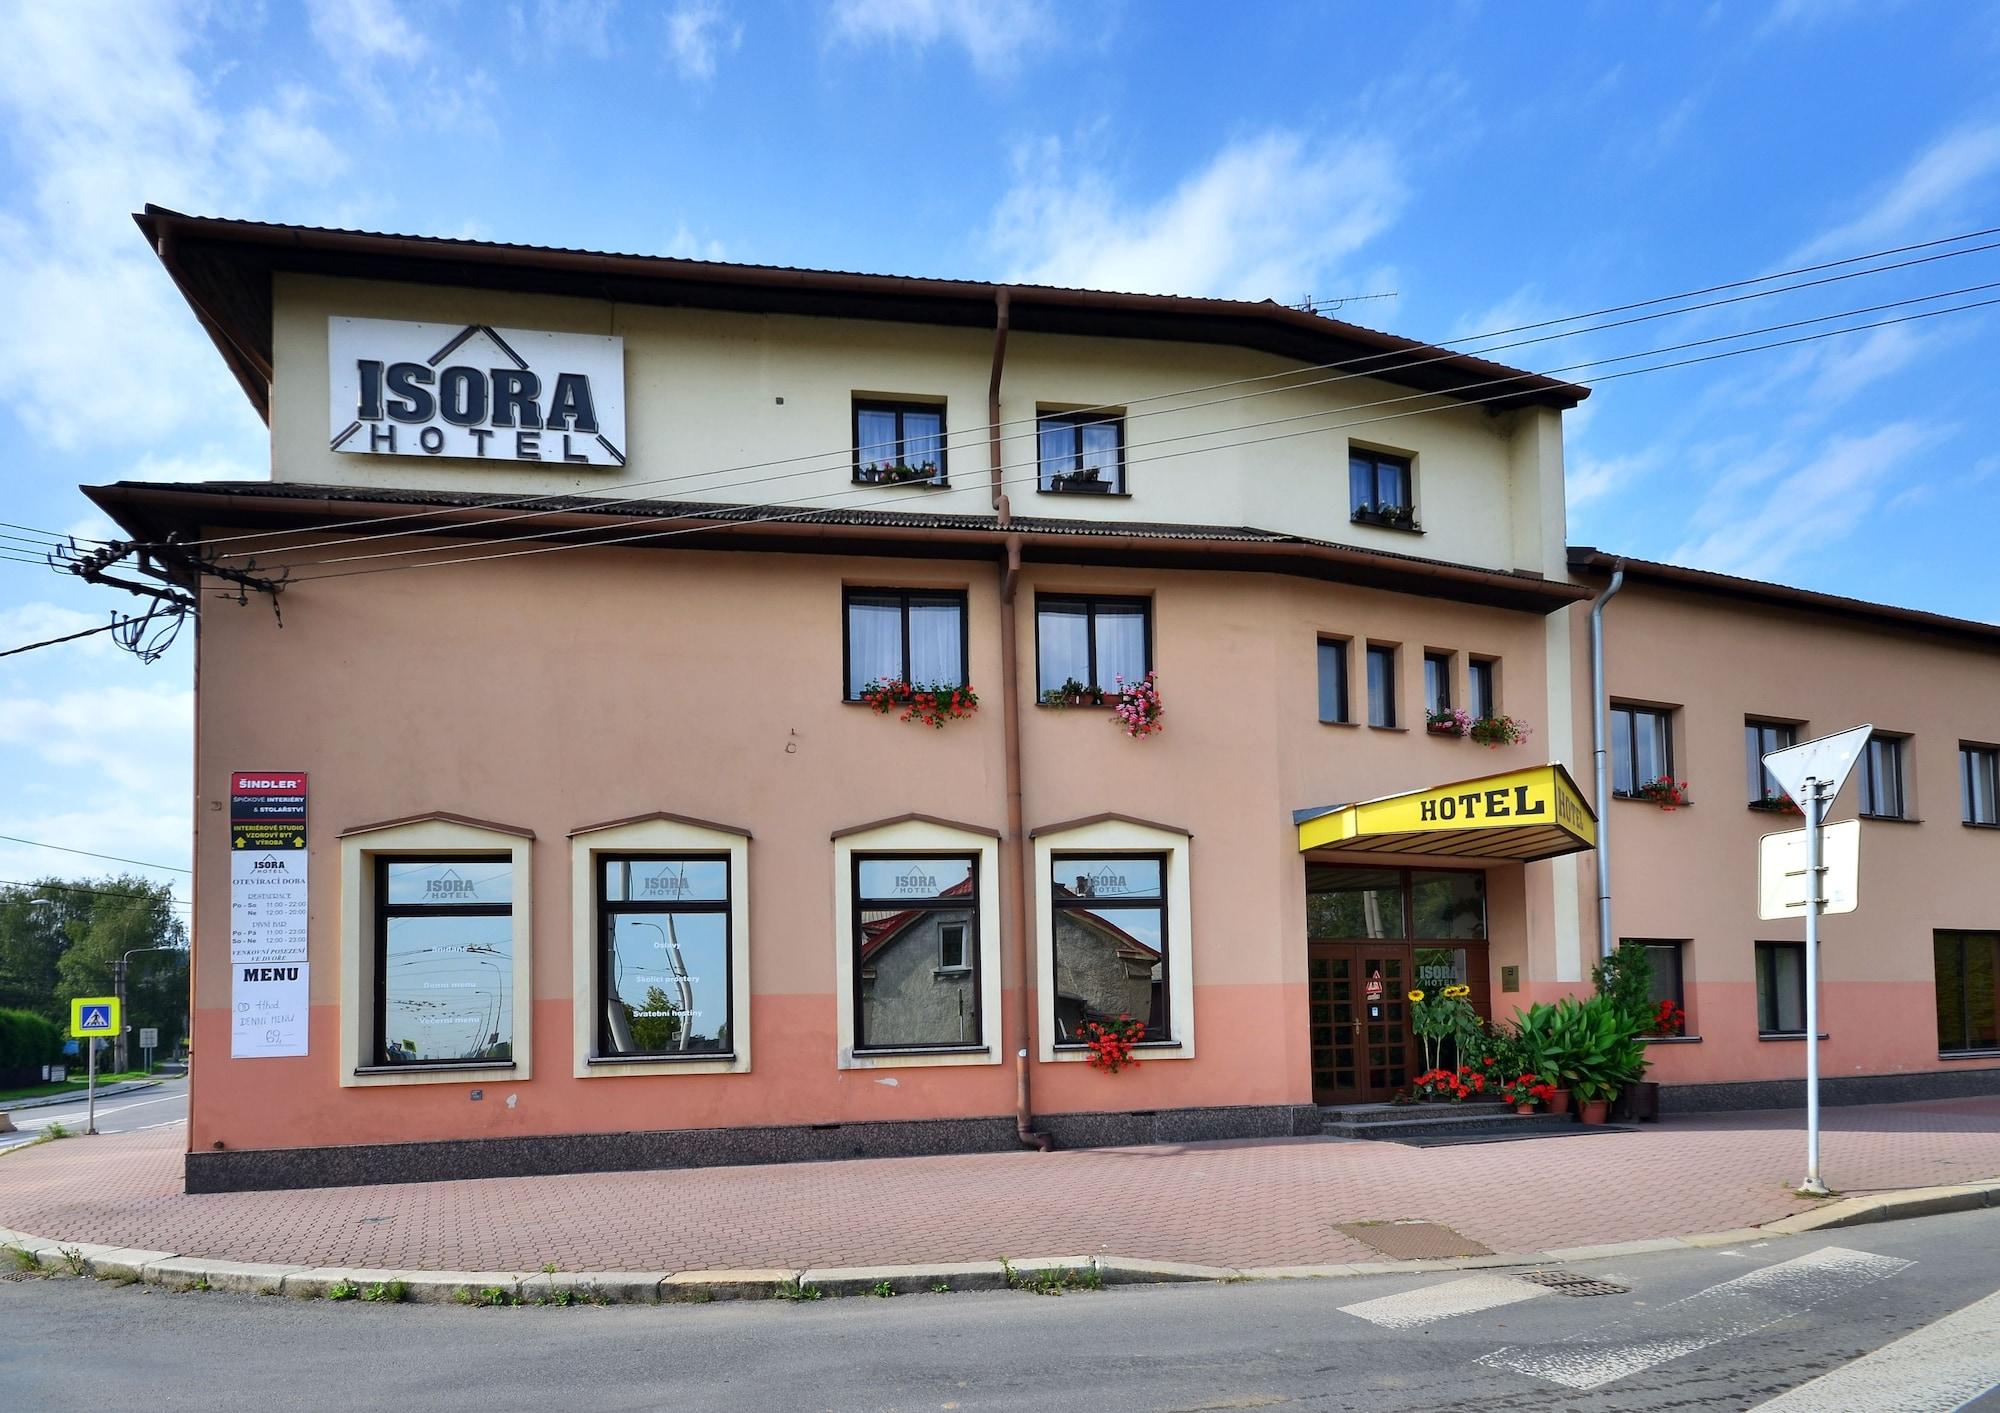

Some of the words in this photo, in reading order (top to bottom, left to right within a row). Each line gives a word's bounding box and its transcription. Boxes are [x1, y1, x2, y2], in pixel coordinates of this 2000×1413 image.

[357, 359, 599, 433] ISORA
[370, 423, 588, 463] HOTEL
[239, 778, 297, 788] ŠINDLER
[1420, 785, 1545, 822] HOTEL
[1557, 786, 1583, 831] HOTEL
[254, 861, 285, 869] ISORA
[233, 877, 280, 885] OTEVÍRACÍ
[426, 880, 475, 891] ISORA
[645, 878, 689, 889] ISORA
[896, 876, 936, 887] ISORA
[1089, 876, 1127, 886] SORA
[244, 967, 299, 982] MENU
[1420, 966, 1457, 980] ISORA
[1424, 979, 1455, 987] HOTEL
